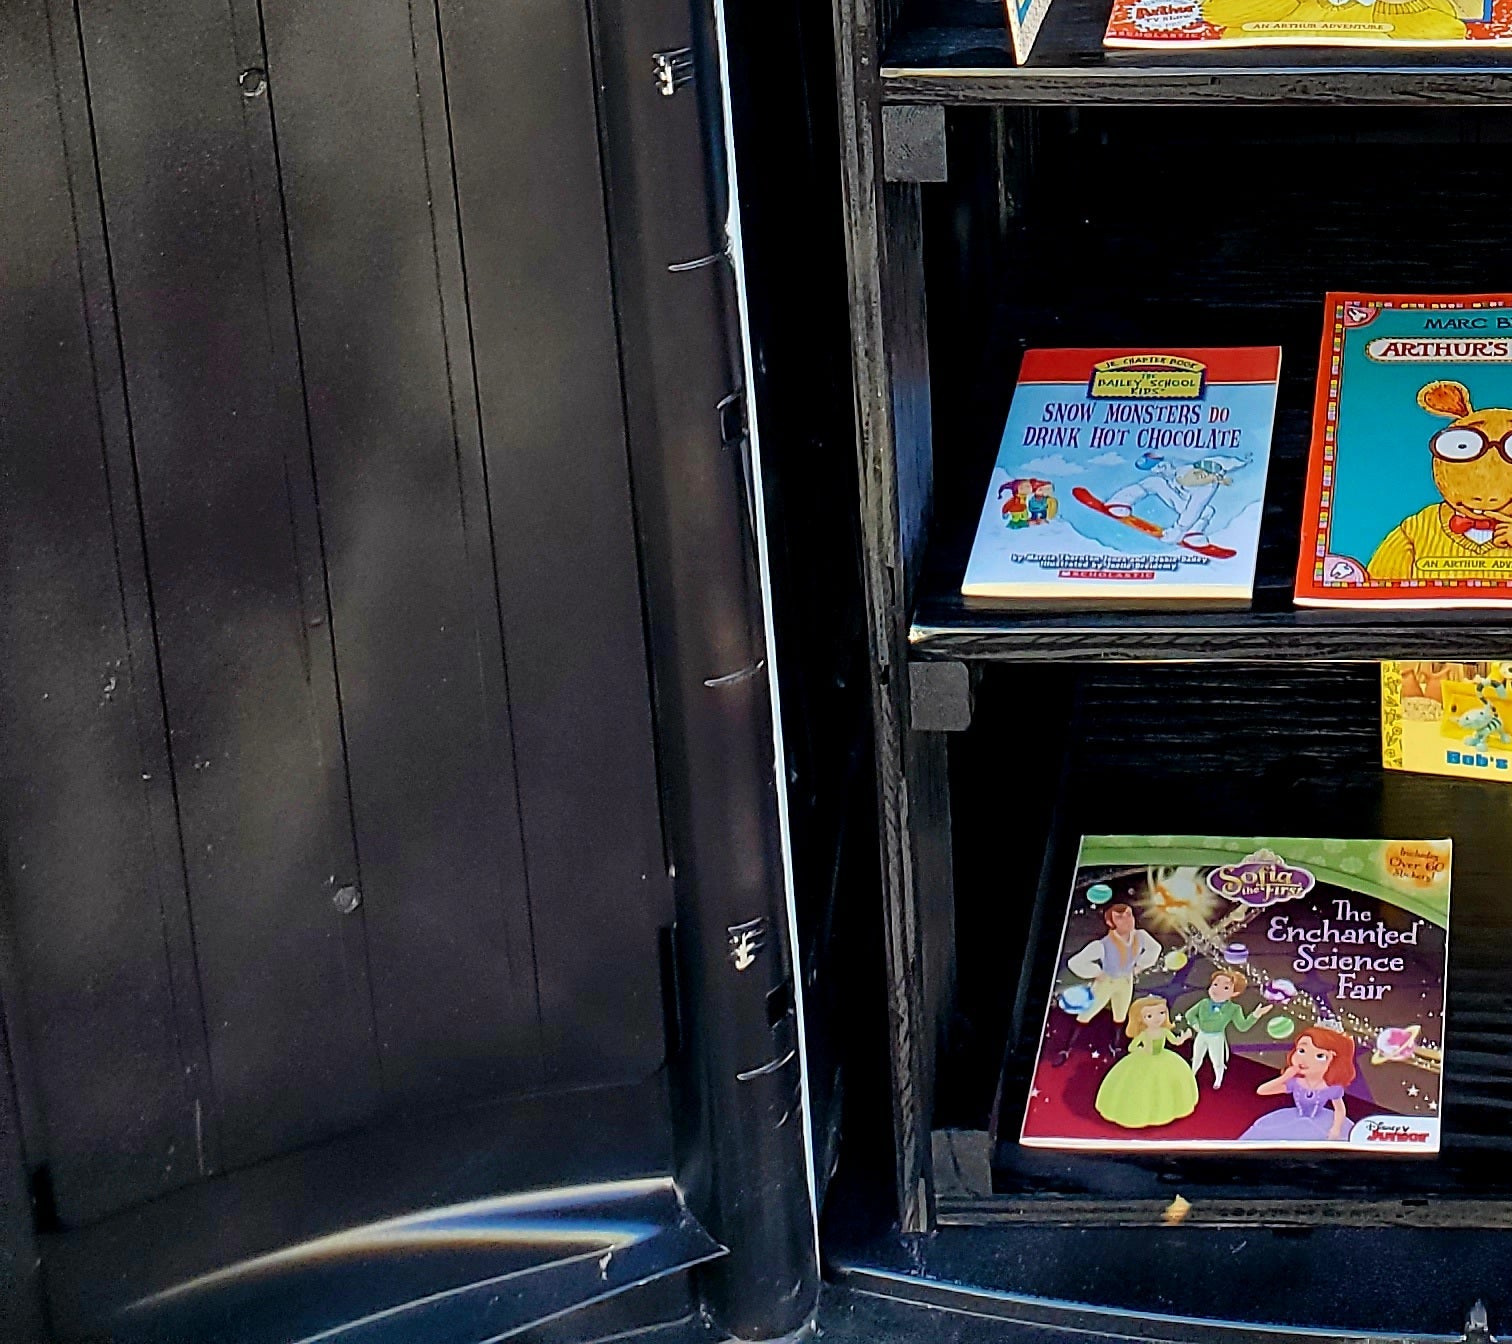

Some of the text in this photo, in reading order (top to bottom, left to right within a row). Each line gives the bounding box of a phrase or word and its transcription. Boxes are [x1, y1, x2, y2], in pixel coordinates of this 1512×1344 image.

[1253, 22, 1386, 31] AN ARTHUR ADVENTURE
[1423, 317, 1488, 330] MARC
[1378, 341, 1509, 357] ARTHUR'S
[1042, 402, 1230, 424] SNOW MONSTERS DO
[1022, 427, 1242, 450] DRINK HOT CHOCOLATE
[1421, 560, 1439, 569] AN
[1442, 560, 1487, 569] ARTHUR
[1446, 750, 1509, 769] Bob's
[1219, 864, 1293, 897] Sofia
[1242, 883, 1303, 901] the First
[1332, 899, 1372, 922] The
[1267, 917, 1420, 948] Enchanted
[1292, 945, 1404, 973] Science
[1336, 973, 1394, 1001] Fair
